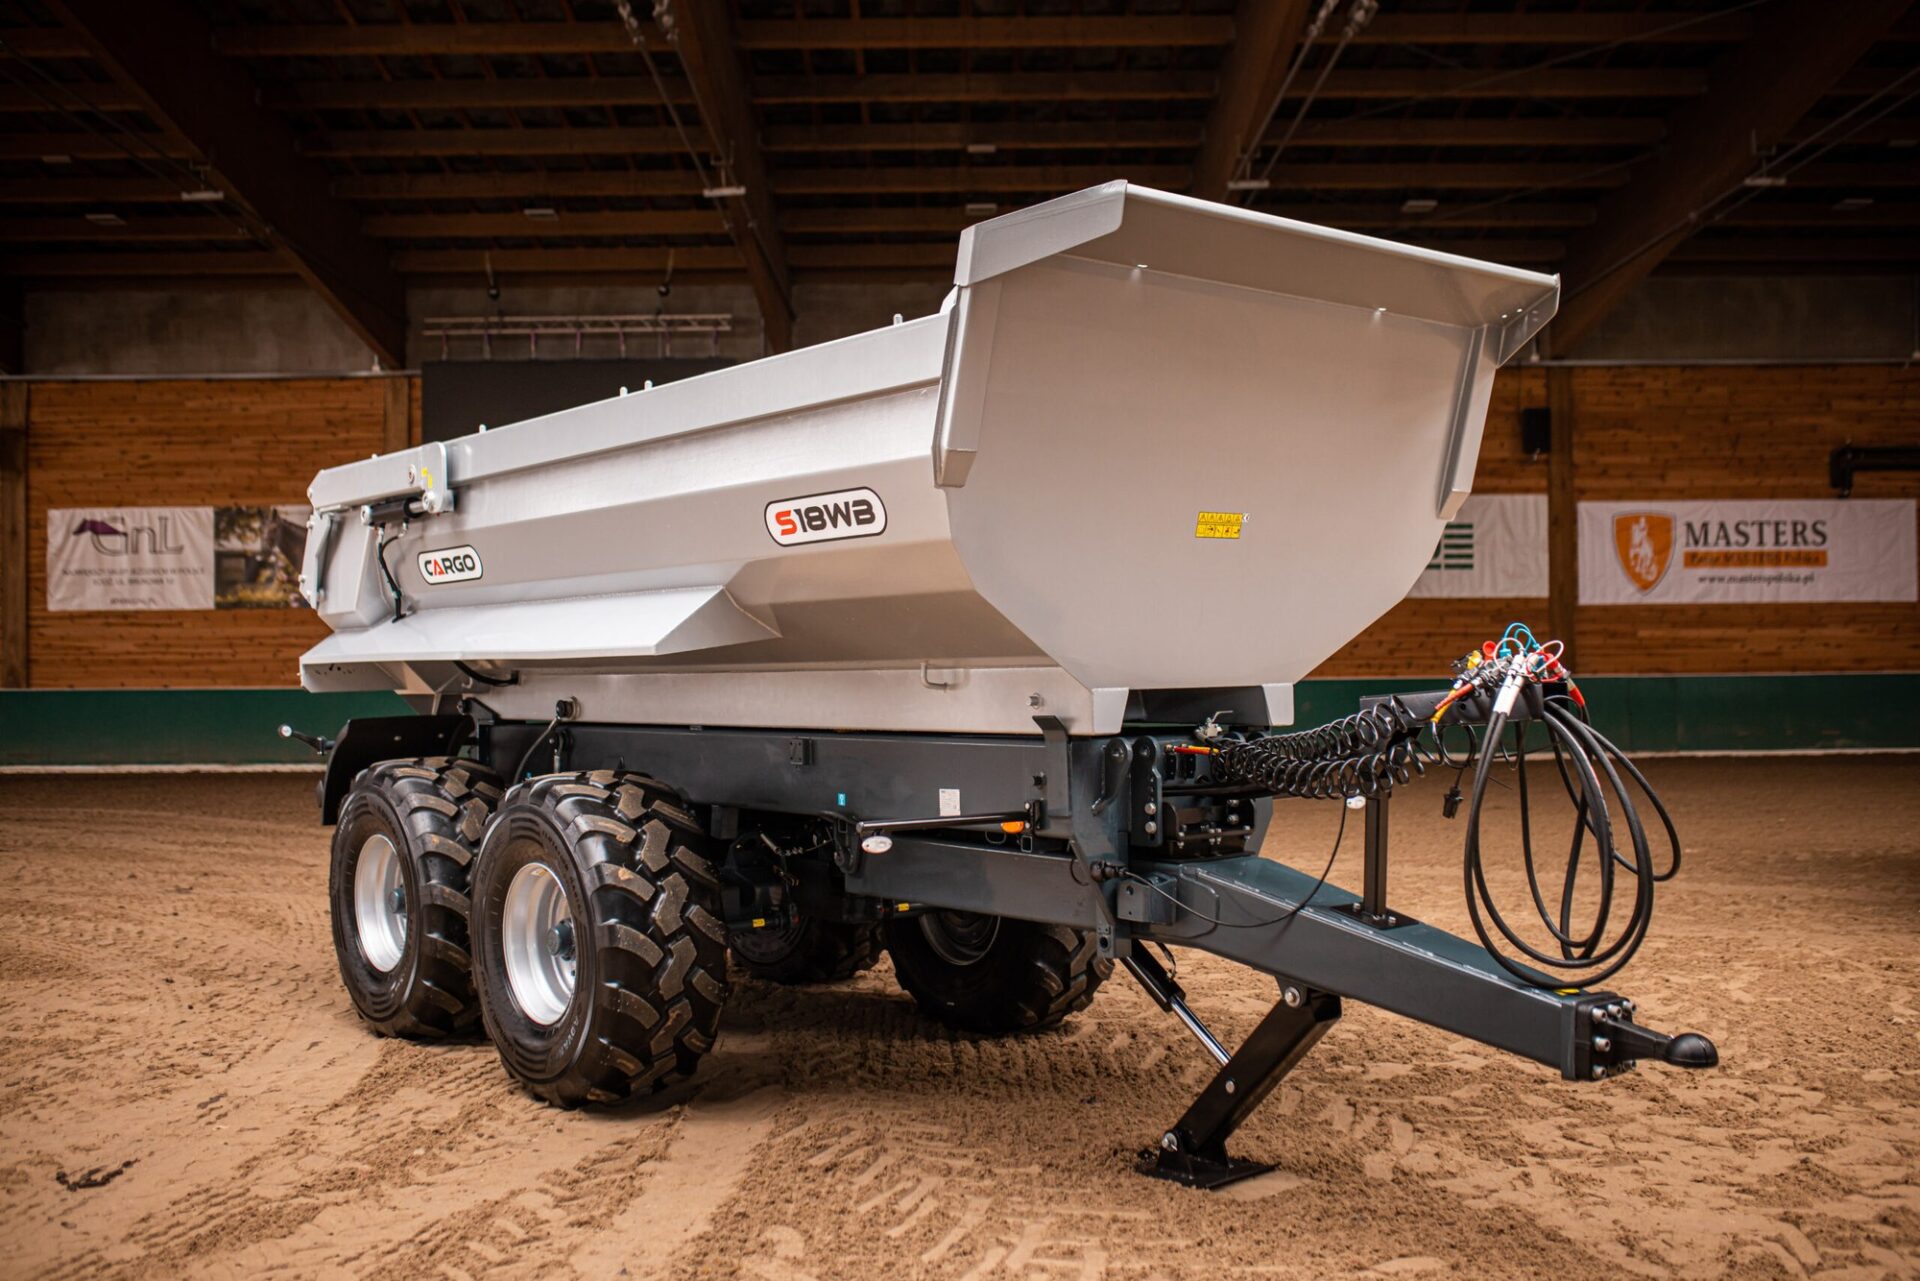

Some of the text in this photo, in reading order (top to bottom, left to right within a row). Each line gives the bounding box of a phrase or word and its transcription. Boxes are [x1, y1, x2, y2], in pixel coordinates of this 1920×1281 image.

[774, 498, 877, 537] S18WB
[1684, 519, 1828, 548] MASTERS
[424, 554, 476, 577] CARGO
